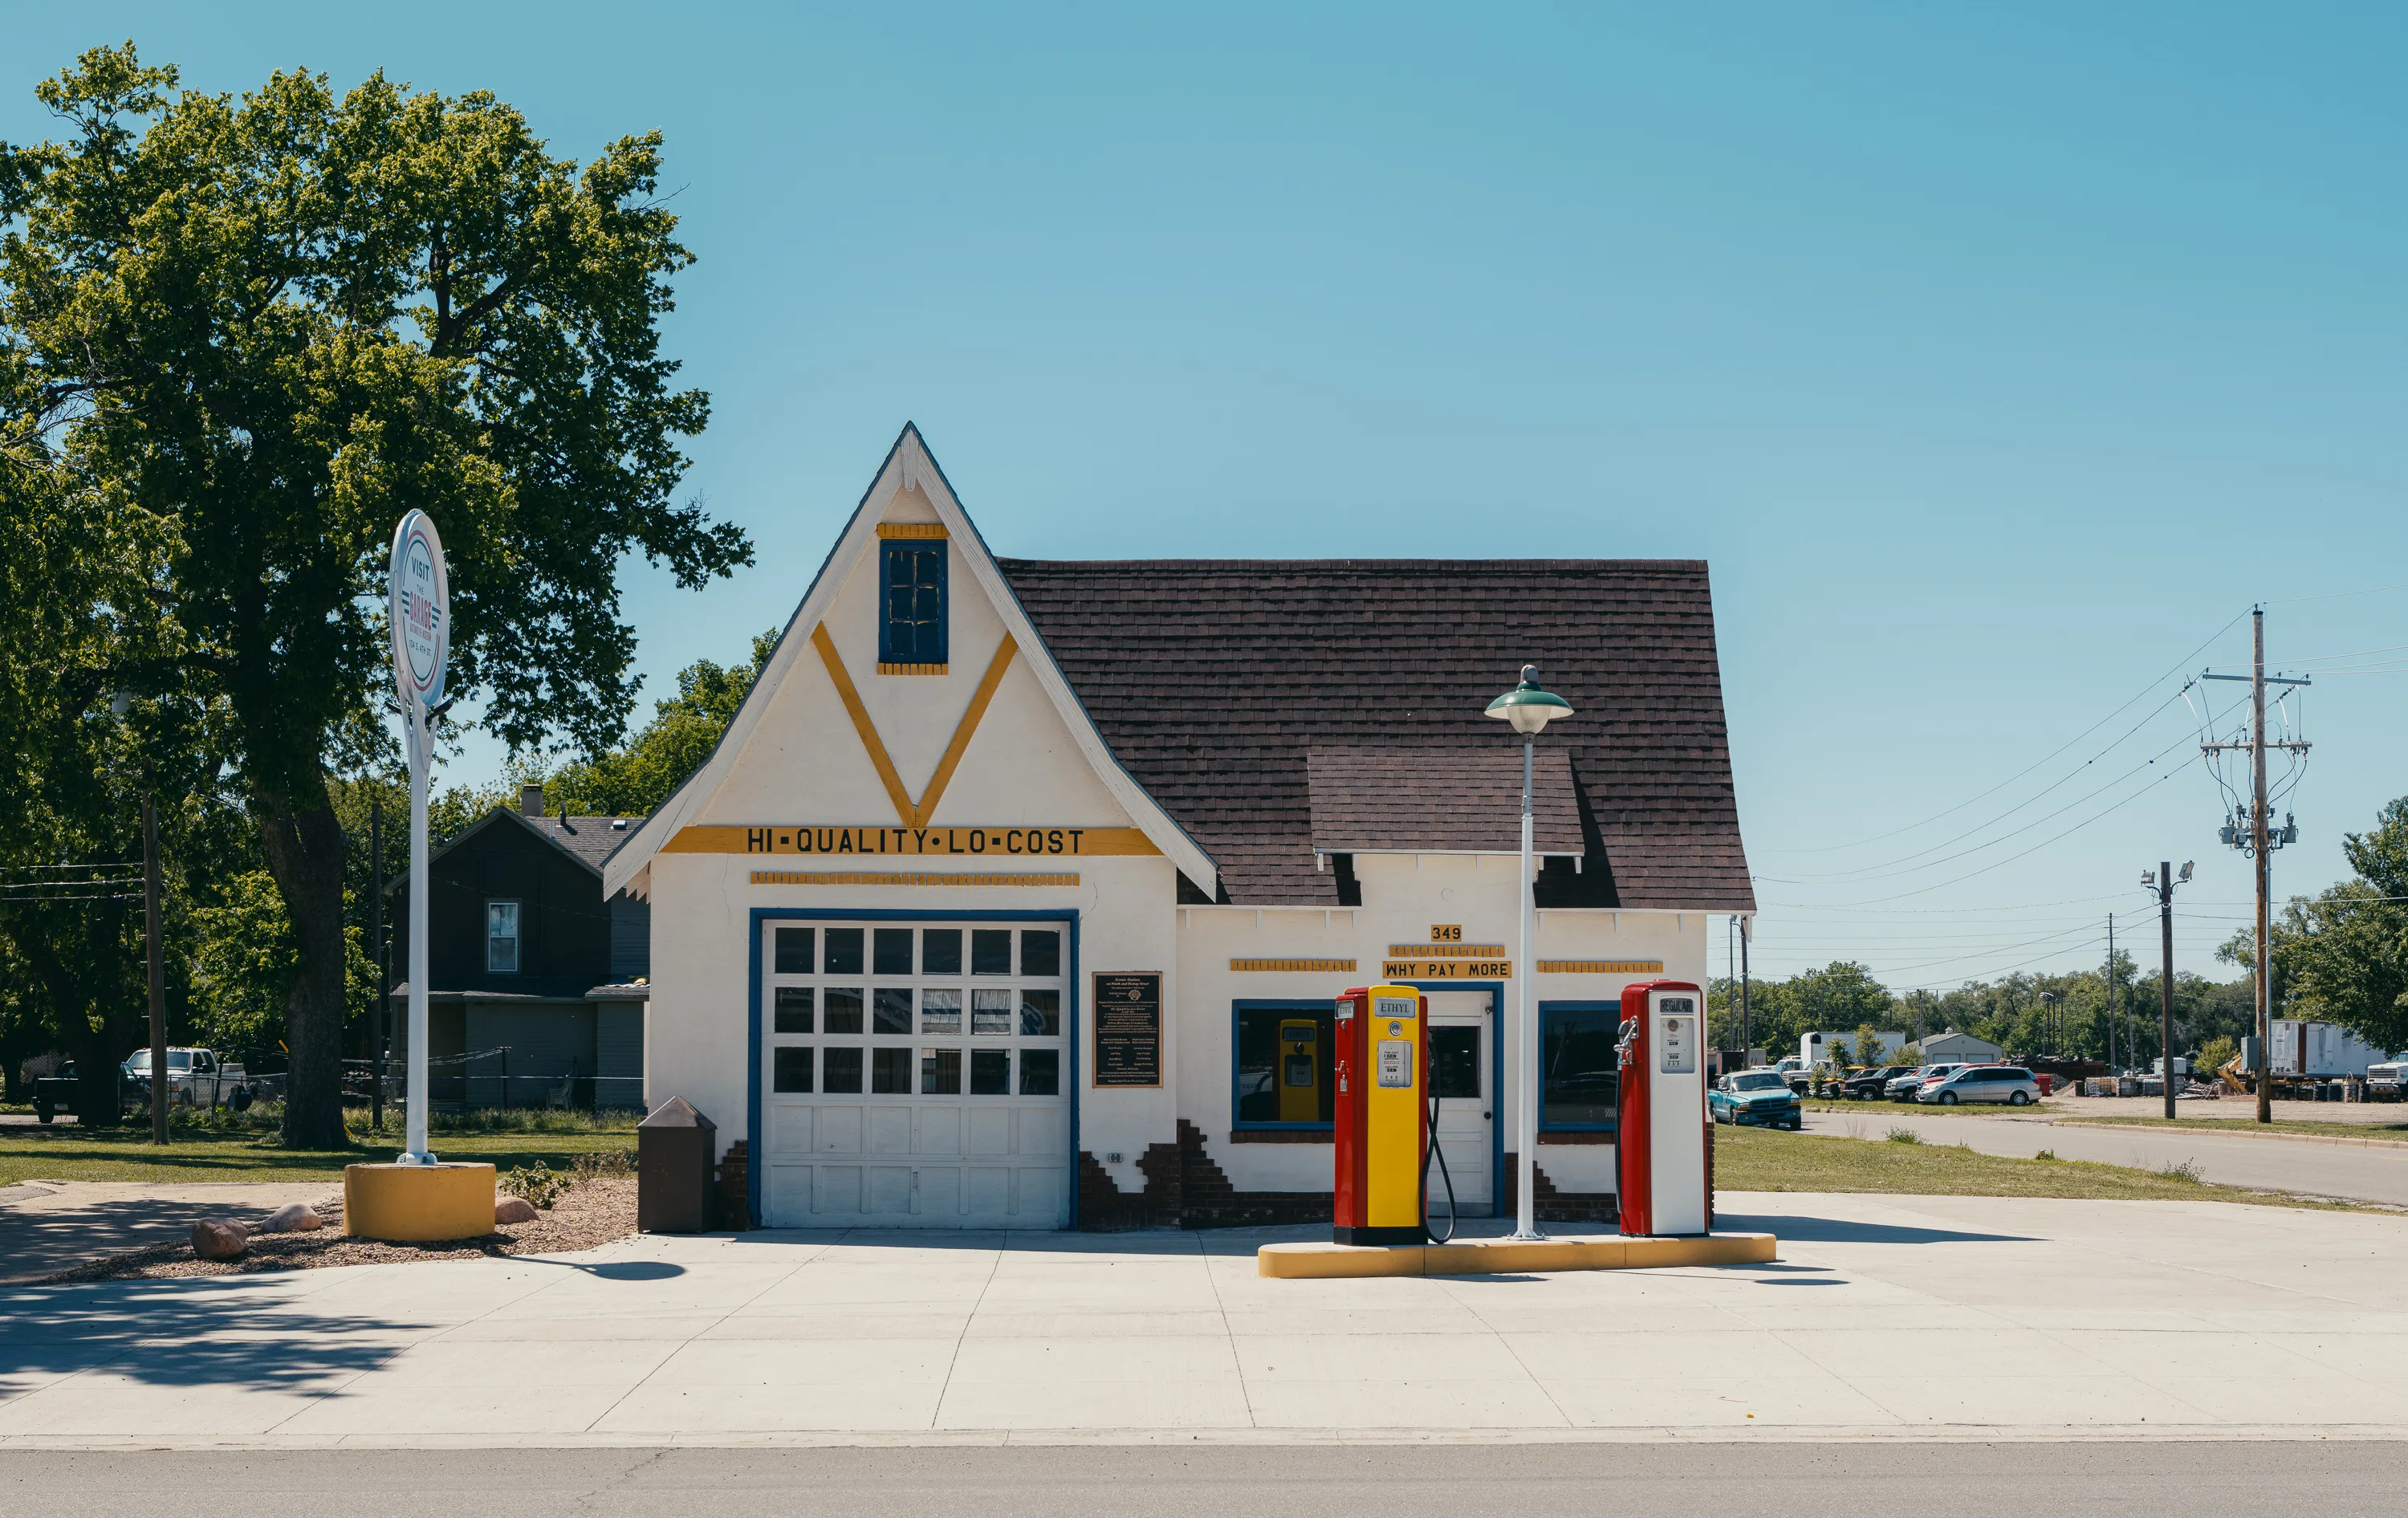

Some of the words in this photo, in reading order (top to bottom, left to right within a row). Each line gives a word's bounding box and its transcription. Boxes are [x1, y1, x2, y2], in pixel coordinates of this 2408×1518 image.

[412, 556, 429, 582] VISIT
[410, 591, 431, 630] GARAGE
[1433, 927, 1461, 939] 349
[1386, 964, 1416, 976] WHY
[1429, 964, 1455, 976] PAY
[1469, 963, 1507, 976] MORE
[1340, 1007, 1352, 1015] ETHYL
[1381, 1003, 1409, 1013] ETHYL
[1661, 999, 1691, 1011] REGULAR
